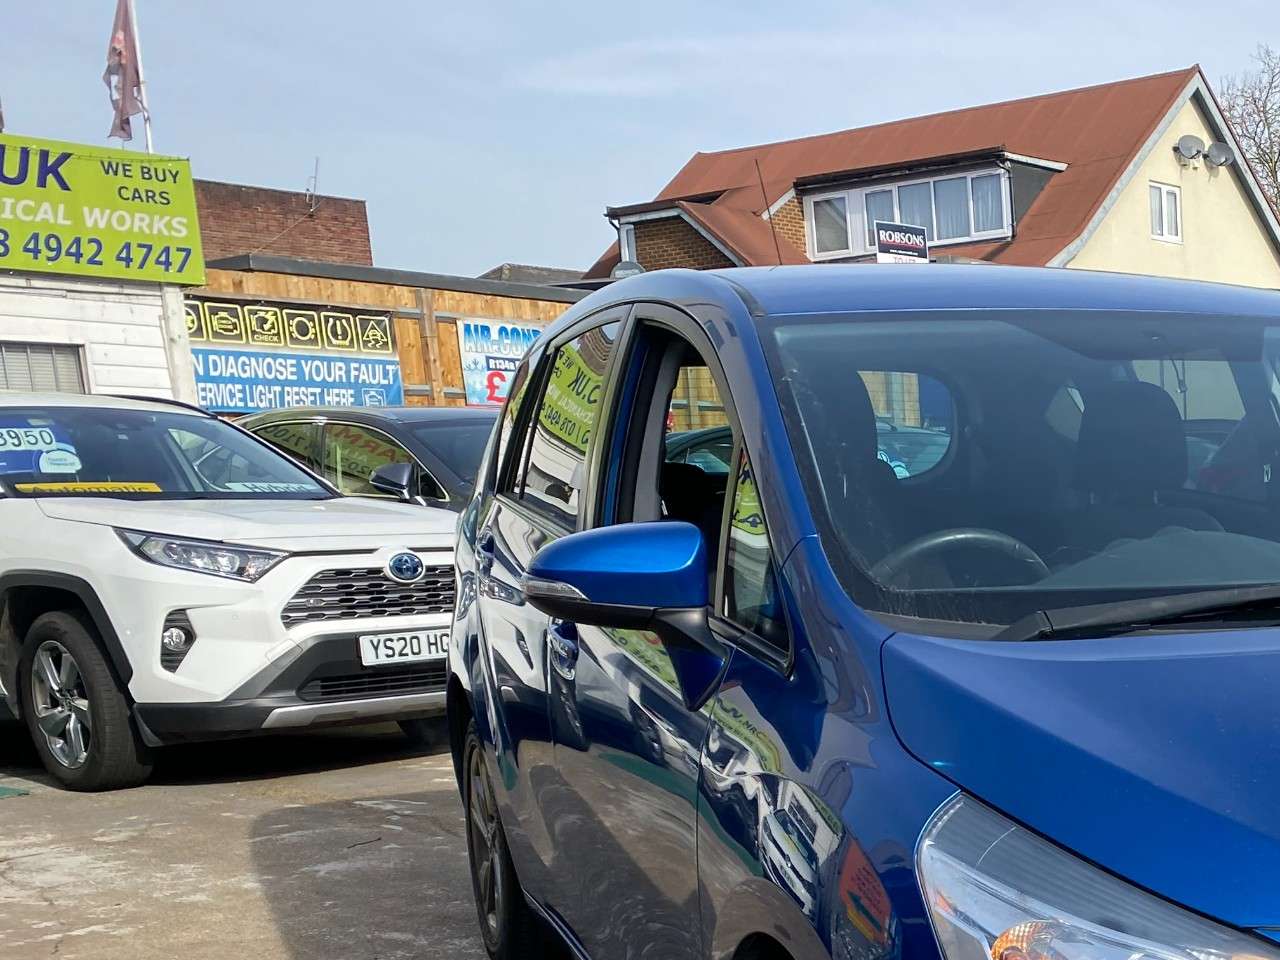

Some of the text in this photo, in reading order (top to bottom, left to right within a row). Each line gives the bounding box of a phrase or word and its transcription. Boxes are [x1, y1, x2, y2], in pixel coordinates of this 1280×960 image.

[0, 144, 73, 191] UK
[101, 160, 180, 184] WE BUY
[117, 185, 172, 205] CARS
[83, 206, 188, 238] WORKS
[879, 229, 925, 248] ROBSONS
[22, 231, 104, 266] 4942
[115, 241, 192, 273] 4747
[253, 334, 279, 343] CHECK
[209, 354, 298, 380] DIAGNOSE
[300, 359, 348, 383] YOUR
[350, 362, 395, 385] FAULT
[199, 382, 245, 407] ERVICE
[246, 385, 282, 409] LIGHT
[284, 387, 321, 408] RESET
[369, 634, 421, 660] YS20
